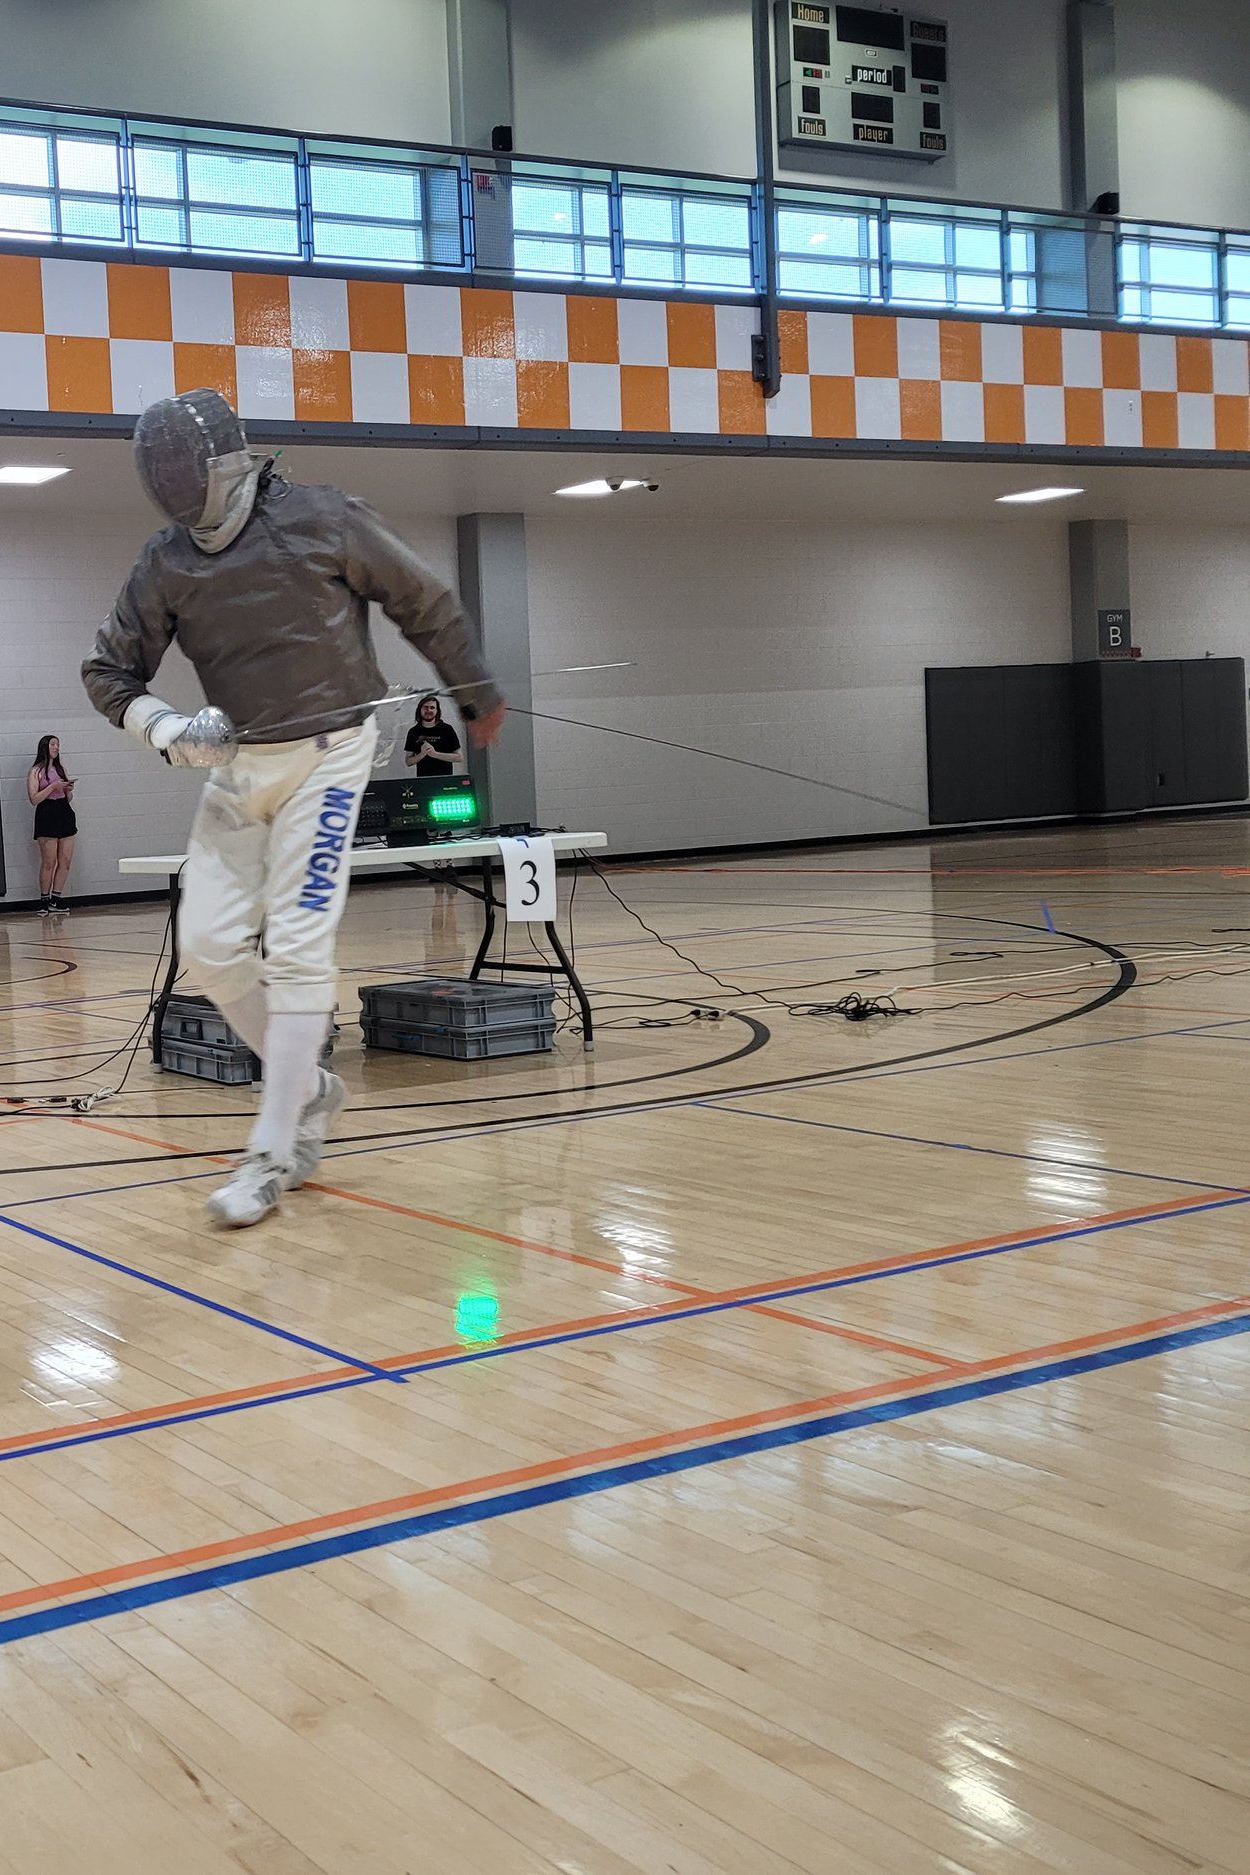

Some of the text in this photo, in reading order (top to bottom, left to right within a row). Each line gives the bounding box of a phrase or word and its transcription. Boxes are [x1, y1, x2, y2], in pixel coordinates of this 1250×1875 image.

[797, 4, 824, 23] Home
[856, 68, 887, 84] period
[801, 119, 824, 135] fouls
[858, 125, 888, 143] player
[922, 134, 944, 150] fouls
[1106, 614, 1123, 623] GYM
[1109, 626, 1122, 646] B
[298, 786, 355, 912] MORGAN
[519, 860, 540, 906] 3
